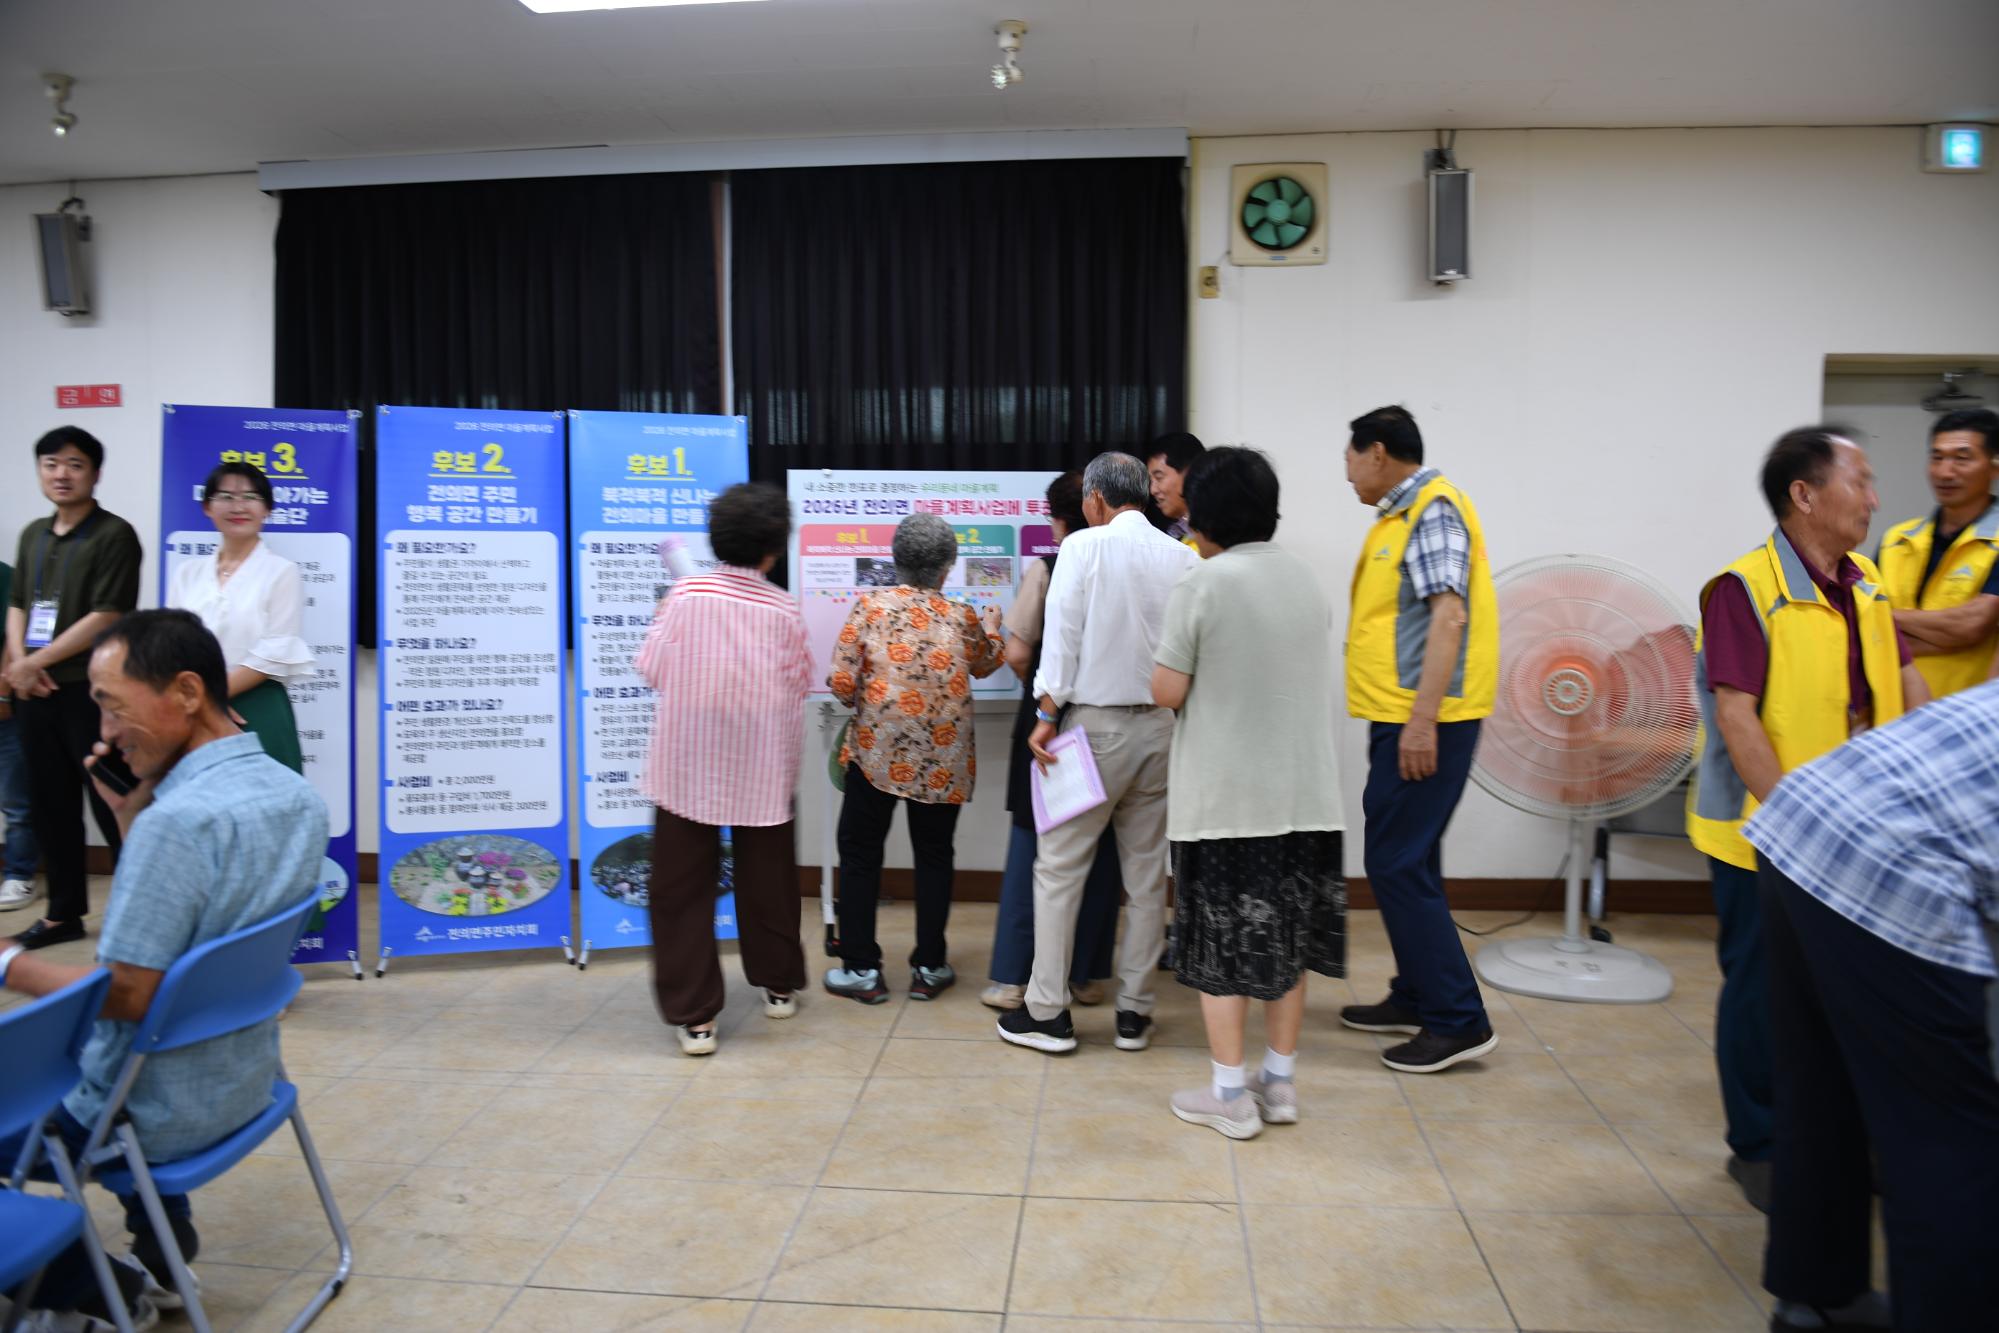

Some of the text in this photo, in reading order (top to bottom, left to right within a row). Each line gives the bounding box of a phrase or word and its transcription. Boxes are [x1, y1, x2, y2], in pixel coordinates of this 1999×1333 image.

[432, 443, 512, 473] 후보 2.
[627, 453, 669, 476] 후보
[427, 485, 517, 503] 전의면 주민
[406, 504, 538, 524] 행복 공간 만들기
[672, 507, 710, 525] 만들
[803, 499, 858, 515] 2026년
[863, 499, 910, 515] 전의면
[913, 499, 1021, 516] 마을계획사업에
[396, 542, 476, 553] 왜 필요한가요?
[396, 638, 477, 649] 무엇을 하나요?
[593, 687, 615, 698] 어떤
[397, 699, 504, 712] 어떤 효과가 있나요?
[397, 776, 433, 787] 사업비
